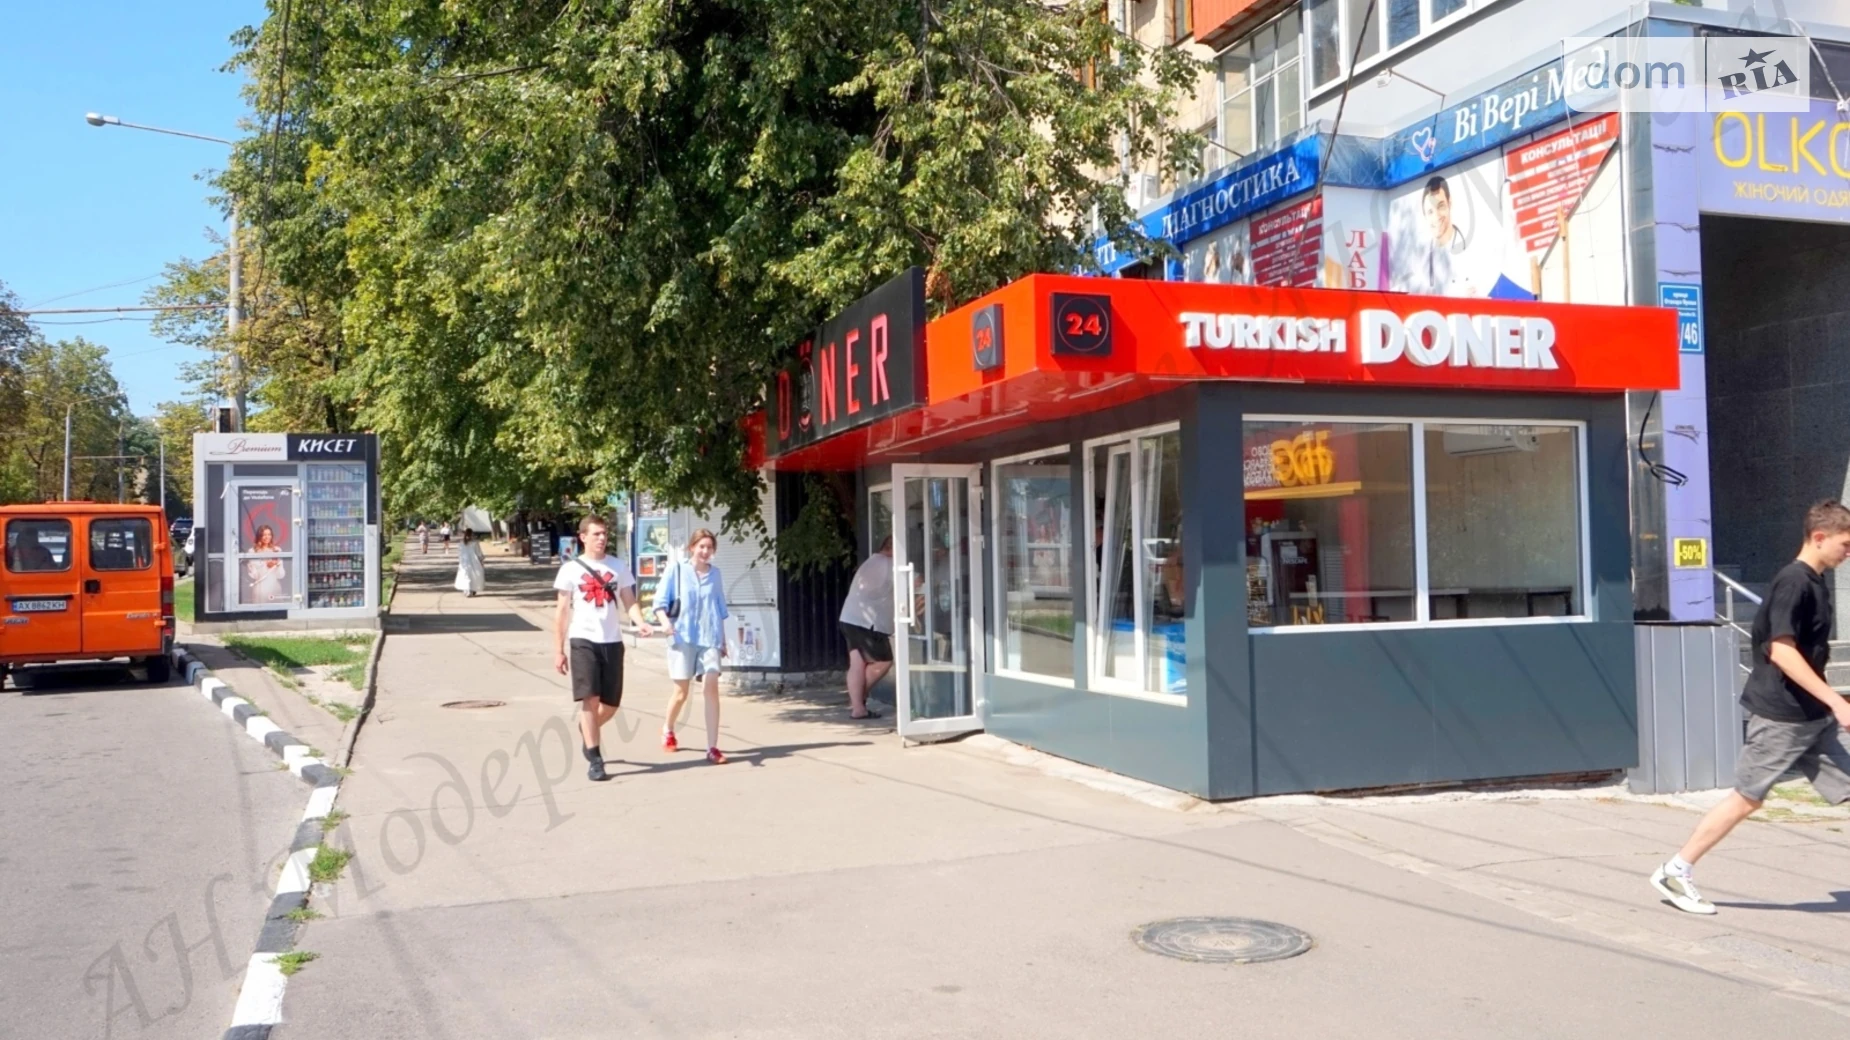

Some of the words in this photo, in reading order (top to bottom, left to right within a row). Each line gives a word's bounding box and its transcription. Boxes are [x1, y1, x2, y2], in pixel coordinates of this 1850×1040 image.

[1482, 83, 1541, 135] Вері
[1520, 121, 1607, 165] КОНСУЛЬТАЦІЇ
[1162, 157, 1299, 239] ДІАГНОСТИКА
[1734, 180, 1810, 205] ЖІНОЧИЙ
[1345, 229, 1368, 289] ЛАБ
[1065, 313, 1103, 337] 24
[976, 326, 993, 351] 24
[1178, 312, 1348, 355] TURKISH
[1360, 309, 1559, 370] DONER
[212, 438, 282, 455] Premium
[297, 438, 358, 454] КИСЕТ
[1679, 544, 1702, 561] -50%
[18, 602, 31, 611] AX
